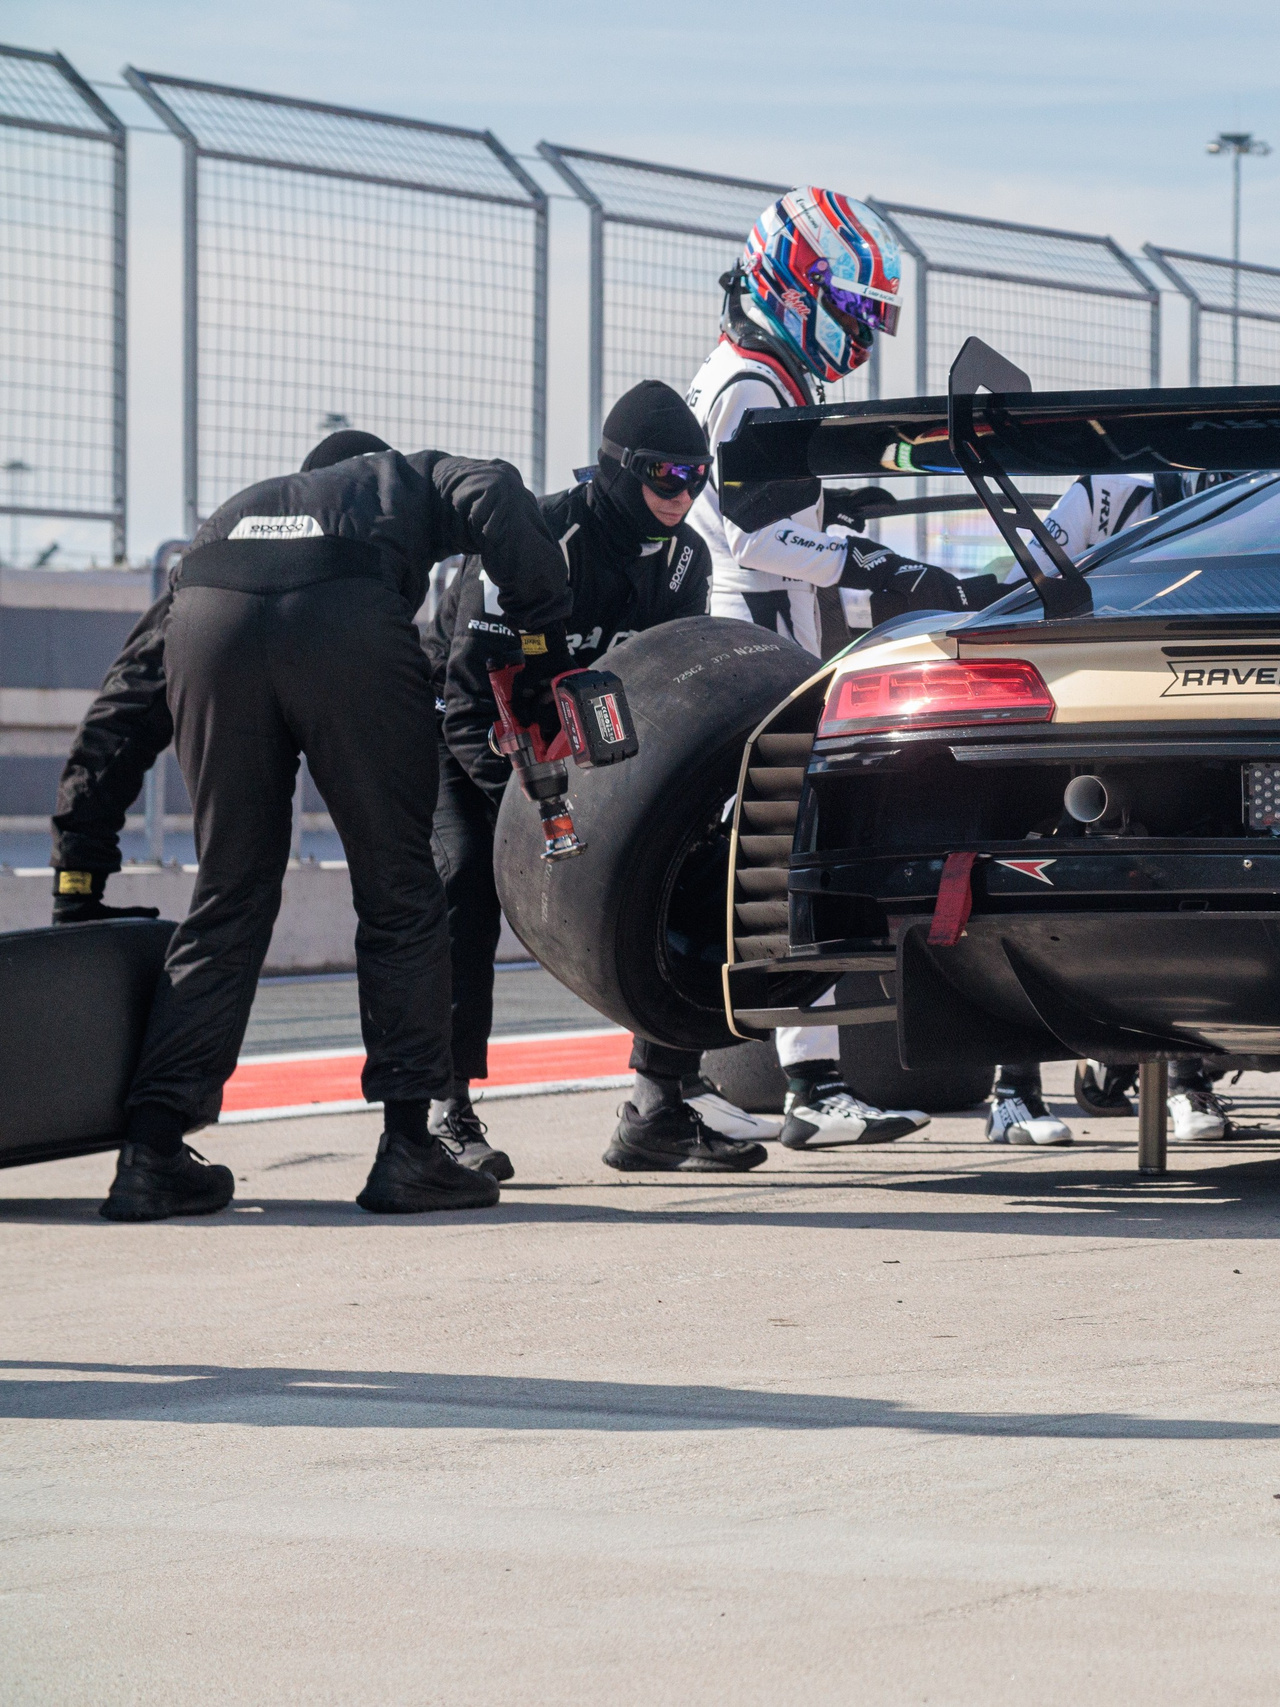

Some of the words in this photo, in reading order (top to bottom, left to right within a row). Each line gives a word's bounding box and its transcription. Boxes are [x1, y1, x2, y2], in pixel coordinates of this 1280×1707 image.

[1098, 489, 1111, 536] HRX
[790, 535, 815, 549] SMP
[669, 545, 693, 592] sparco
